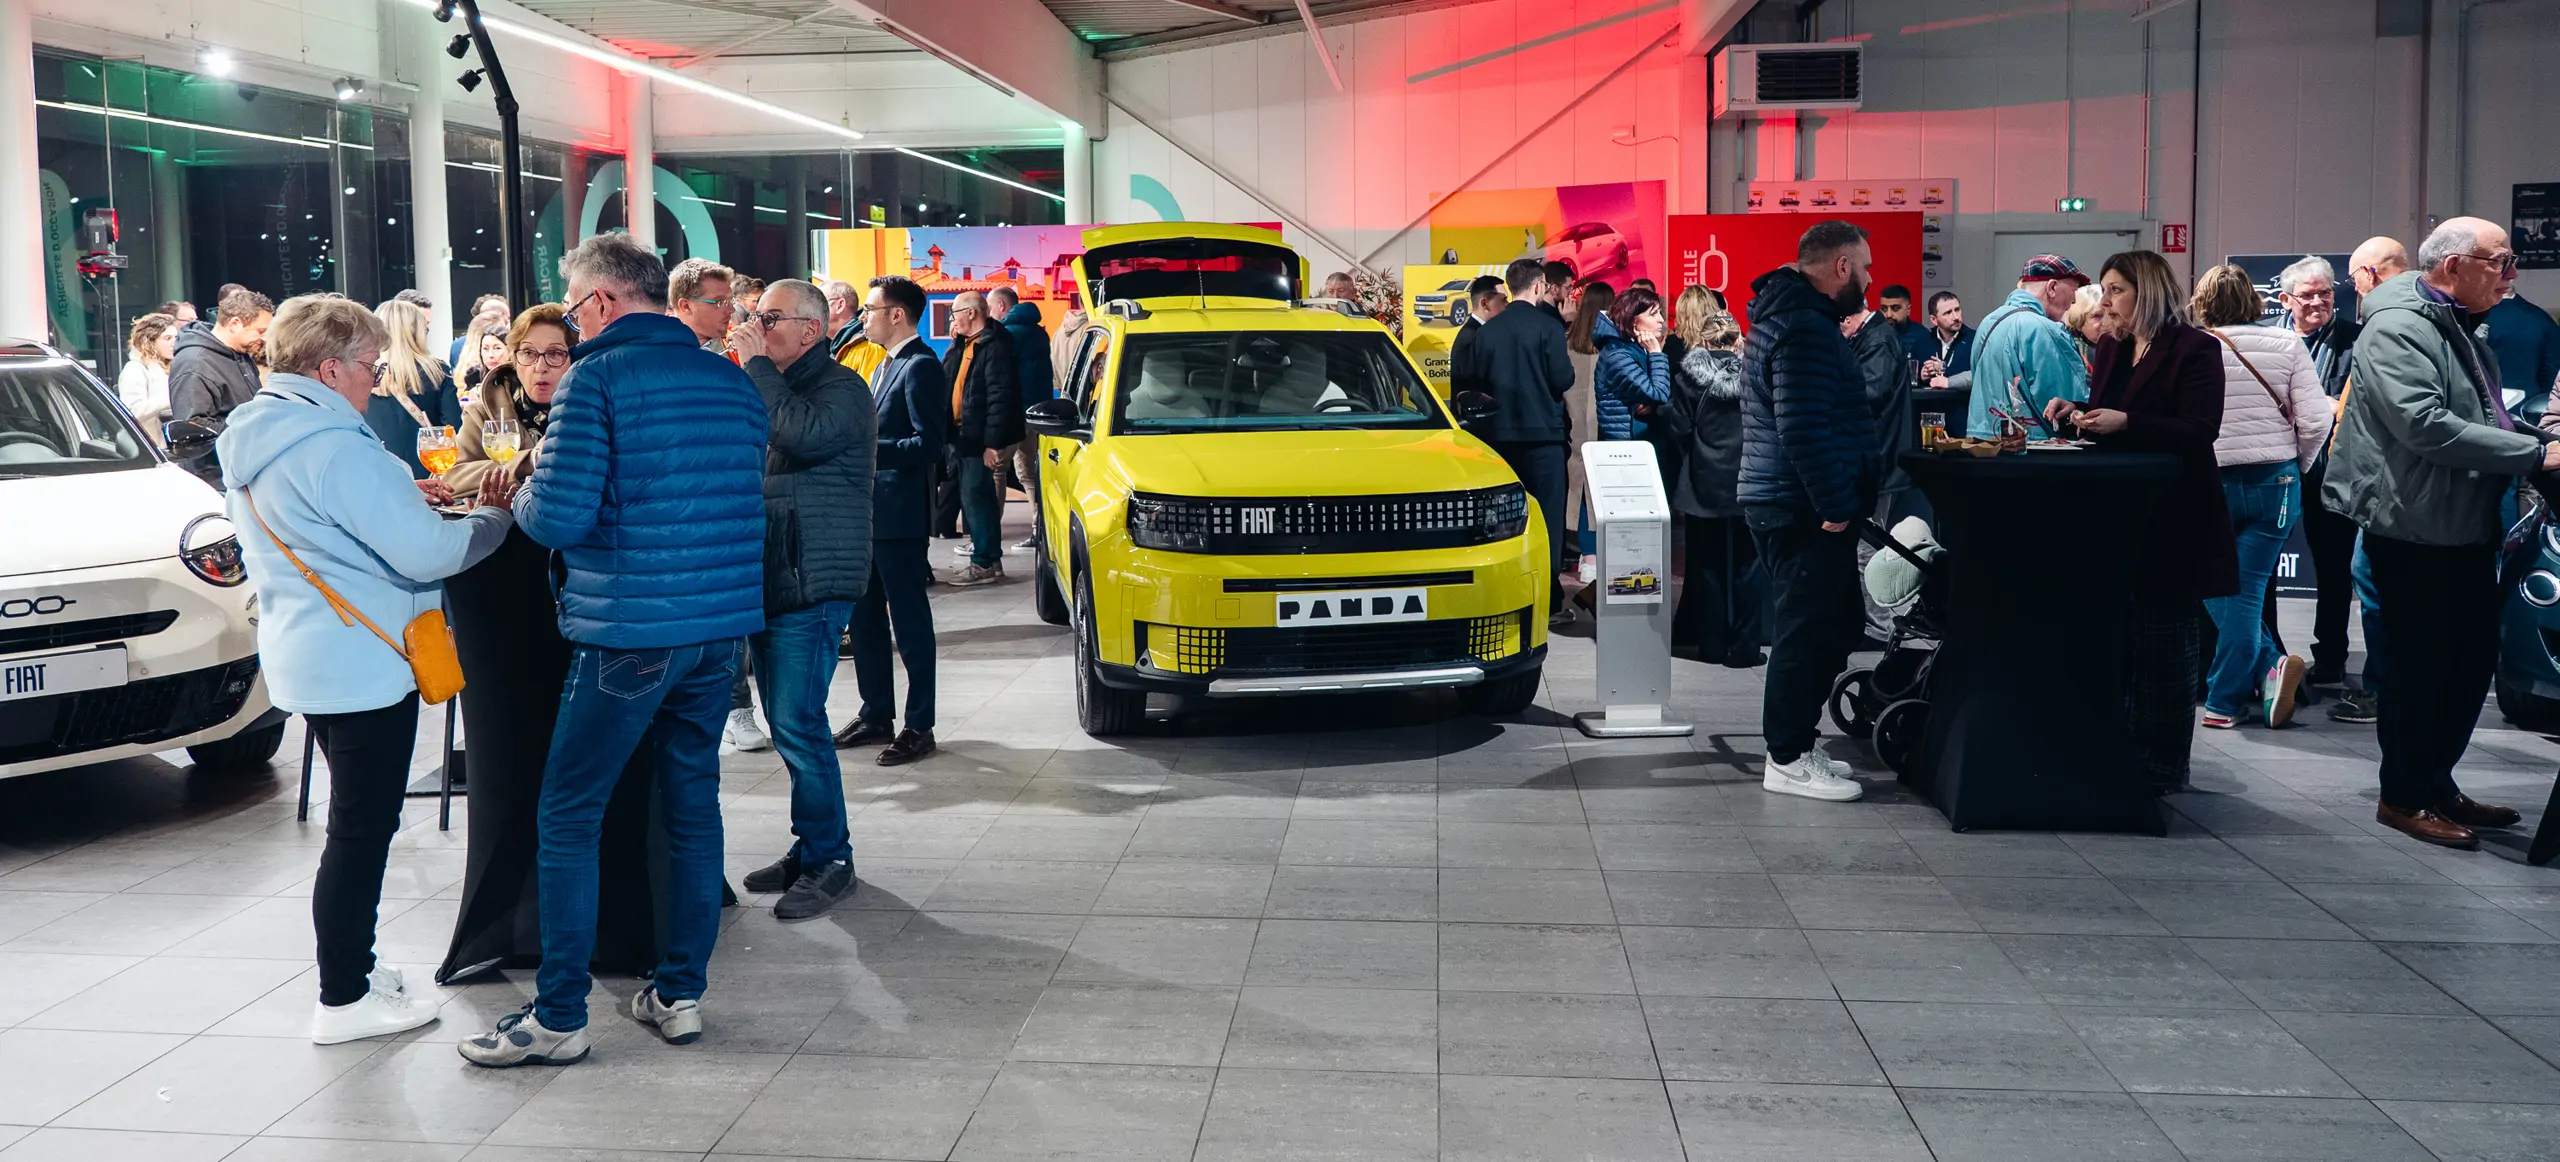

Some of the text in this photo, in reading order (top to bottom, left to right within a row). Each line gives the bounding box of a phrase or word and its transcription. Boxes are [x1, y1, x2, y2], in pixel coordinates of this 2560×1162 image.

[1241, 508, 1275, 534] FIAT
[2278, 553, 2299, 577] AT
[0, 595, 76, 618] 00
[1279, 595, 1424, 620] PANDA
[6, 664, 46, 694] FIAT
